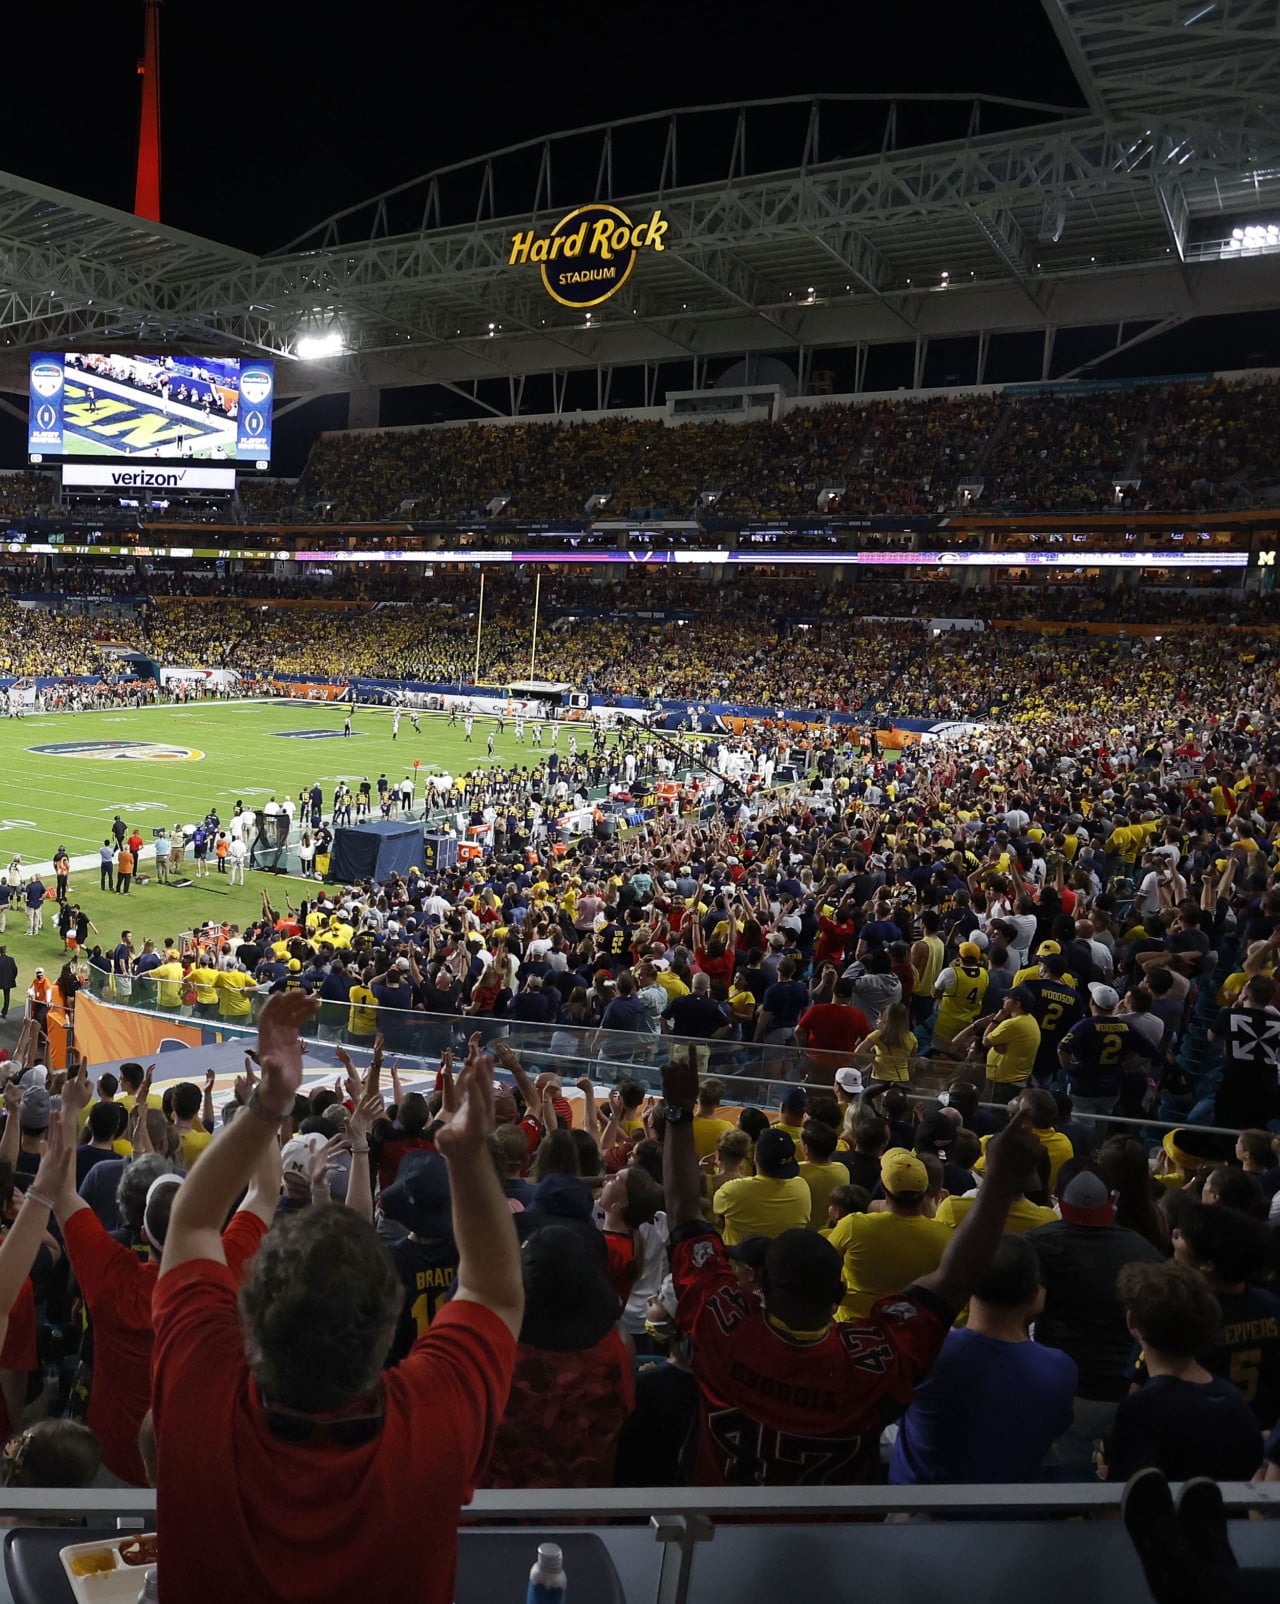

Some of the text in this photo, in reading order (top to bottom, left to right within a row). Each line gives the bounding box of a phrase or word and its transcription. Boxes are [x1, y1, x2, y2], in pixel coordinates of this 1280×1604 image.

[508, 210, 668, 265] Hard Rock
[558, 266, 616, 285] STADIUM
[111, 469, 178, 486] verizon
[1257, 551, 1276, 566] M
[110, 801, 168, 812] 30
[460, 847, 469, 858] G
[611, 937, 625, 954] 55
[967, 987, 978, 1004] 4
[1040, 988, 1077, 1007] WOODSON
[1041, 1002, 1065, 1031] 2
[1094, 1022, 1130, 1033] WOODSON
[1099, 1033, 1123, 1065] 2
[705, 1285, 751, 1337] 47
[839, 1326, 895, 1374] 47
[708, 1406, 861, 1486] 47
